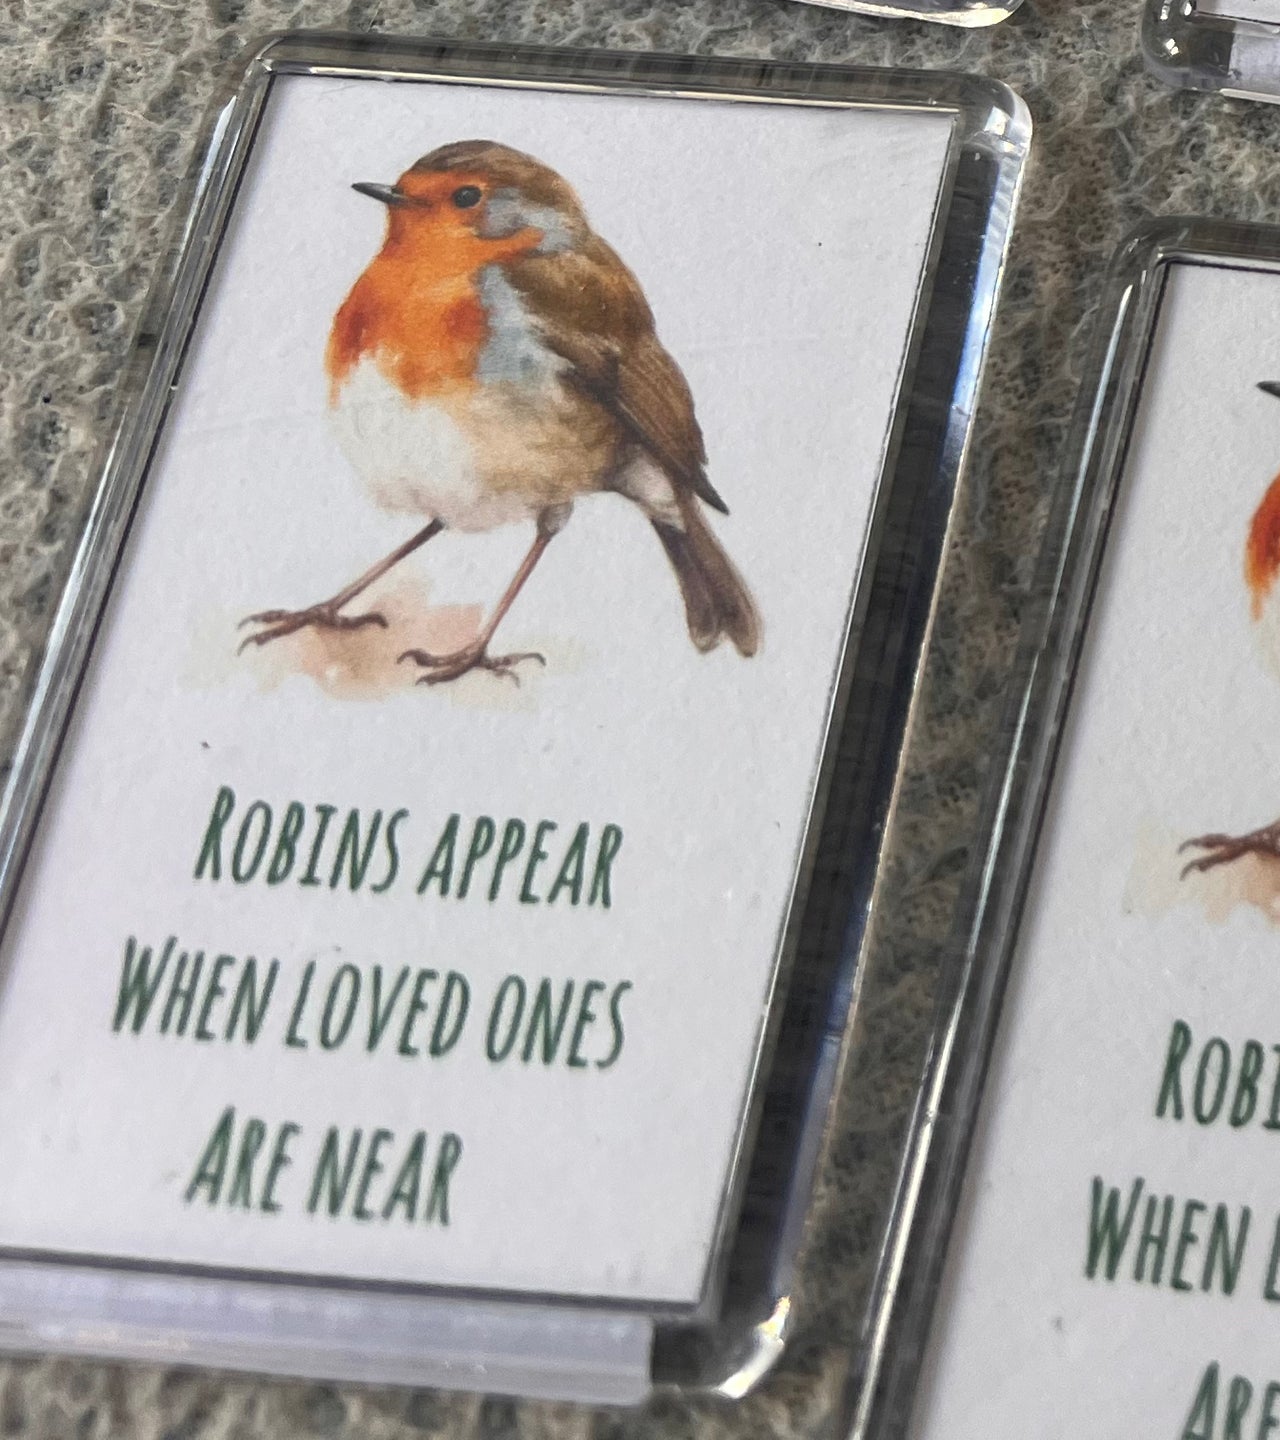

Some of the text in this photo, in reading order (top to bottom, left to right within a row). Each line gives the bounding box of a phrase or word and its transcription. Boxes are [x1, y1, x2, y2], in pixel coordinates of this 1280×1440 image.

[192, 784, 624, 911] ROBINS APPEAR
[110, 934, 634, 1071] WHEN LOVED ONES
[183, 1105, 464, 1228] ARE NEAR
[1083, 1174, 1253, 1298] WHEN
